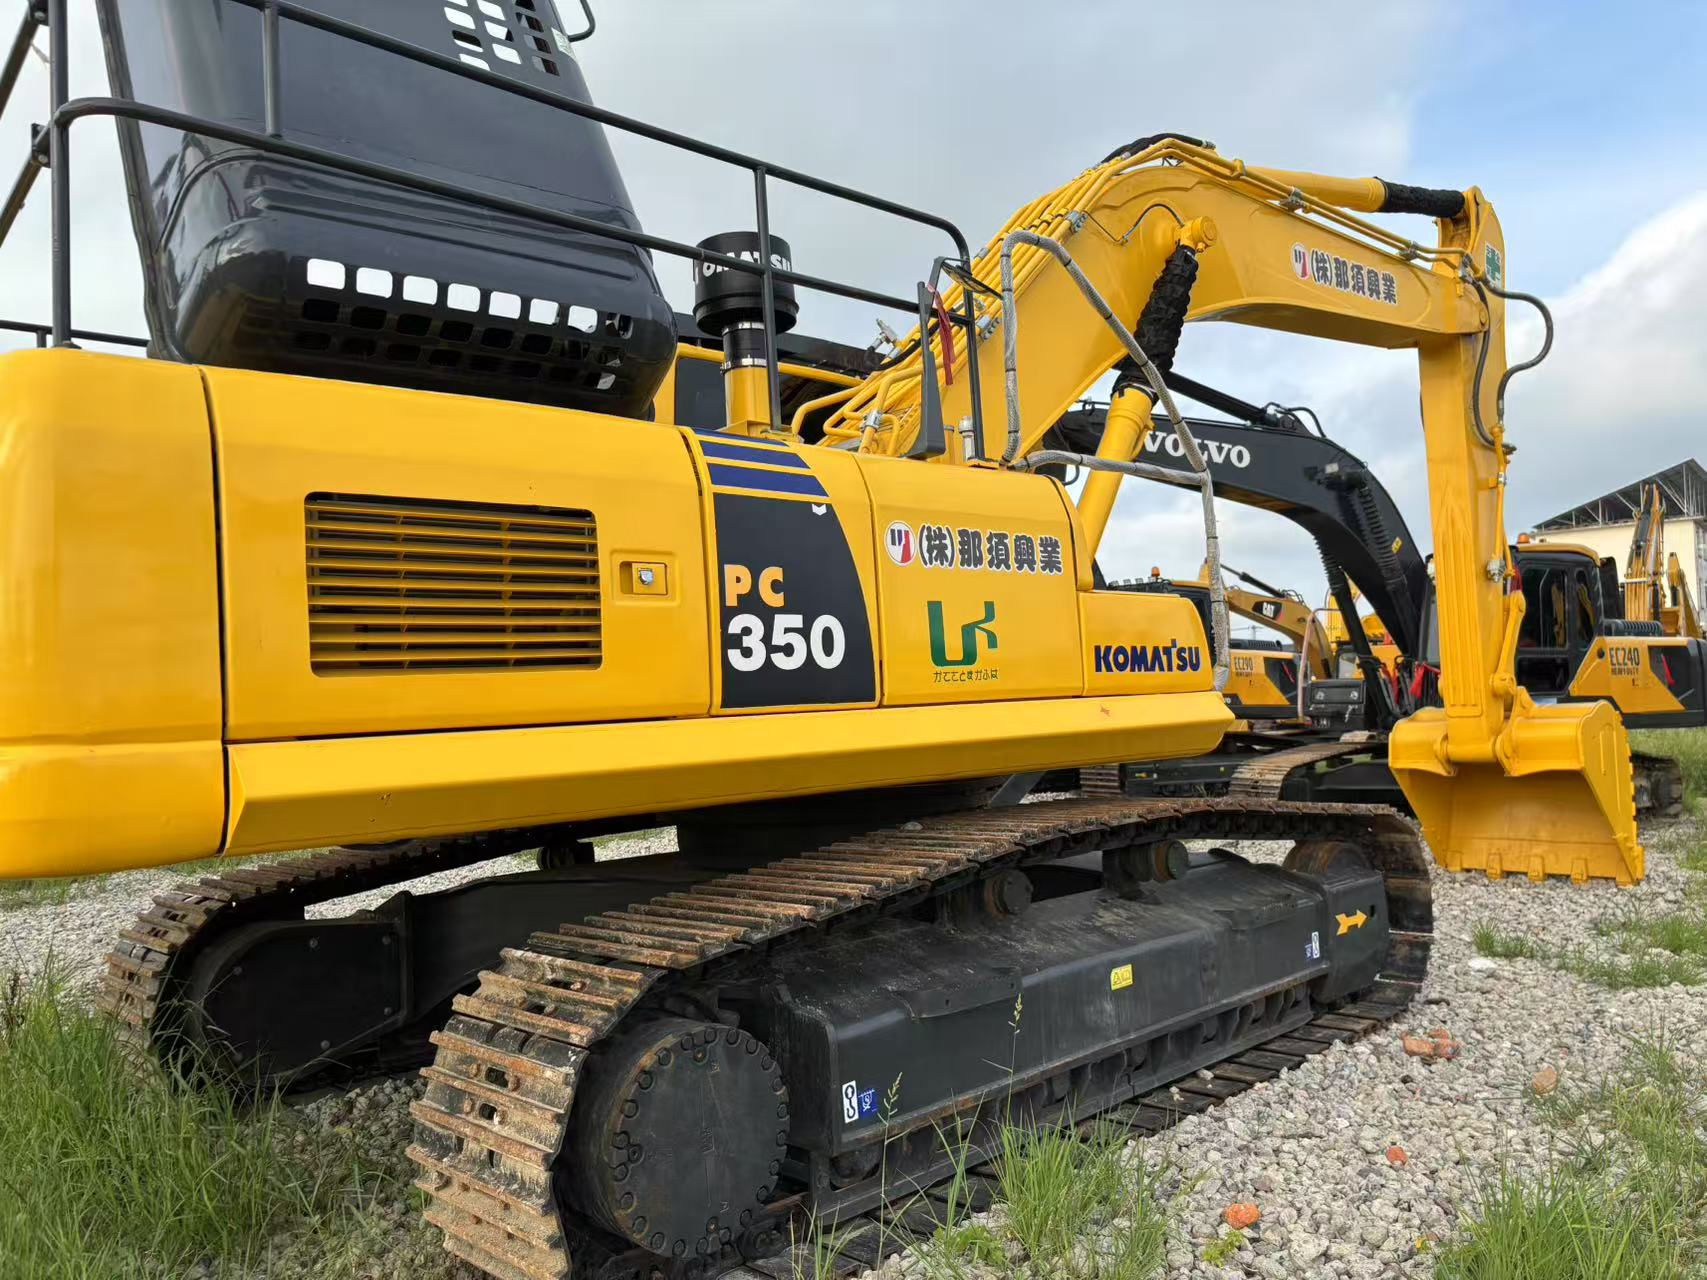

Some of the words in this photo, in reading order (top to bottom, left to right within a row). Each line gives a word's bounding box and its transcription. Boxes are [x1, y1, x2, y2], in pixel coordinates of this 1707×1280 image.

[918, 524, 1062, 574] (株)那須興業
[724, 564, 785, 608] PC
[727, 613, 846, 672] 350
[1094, 639, 1201, 673] KOMATSU
[1609, 647, 1640, 666] EC240
